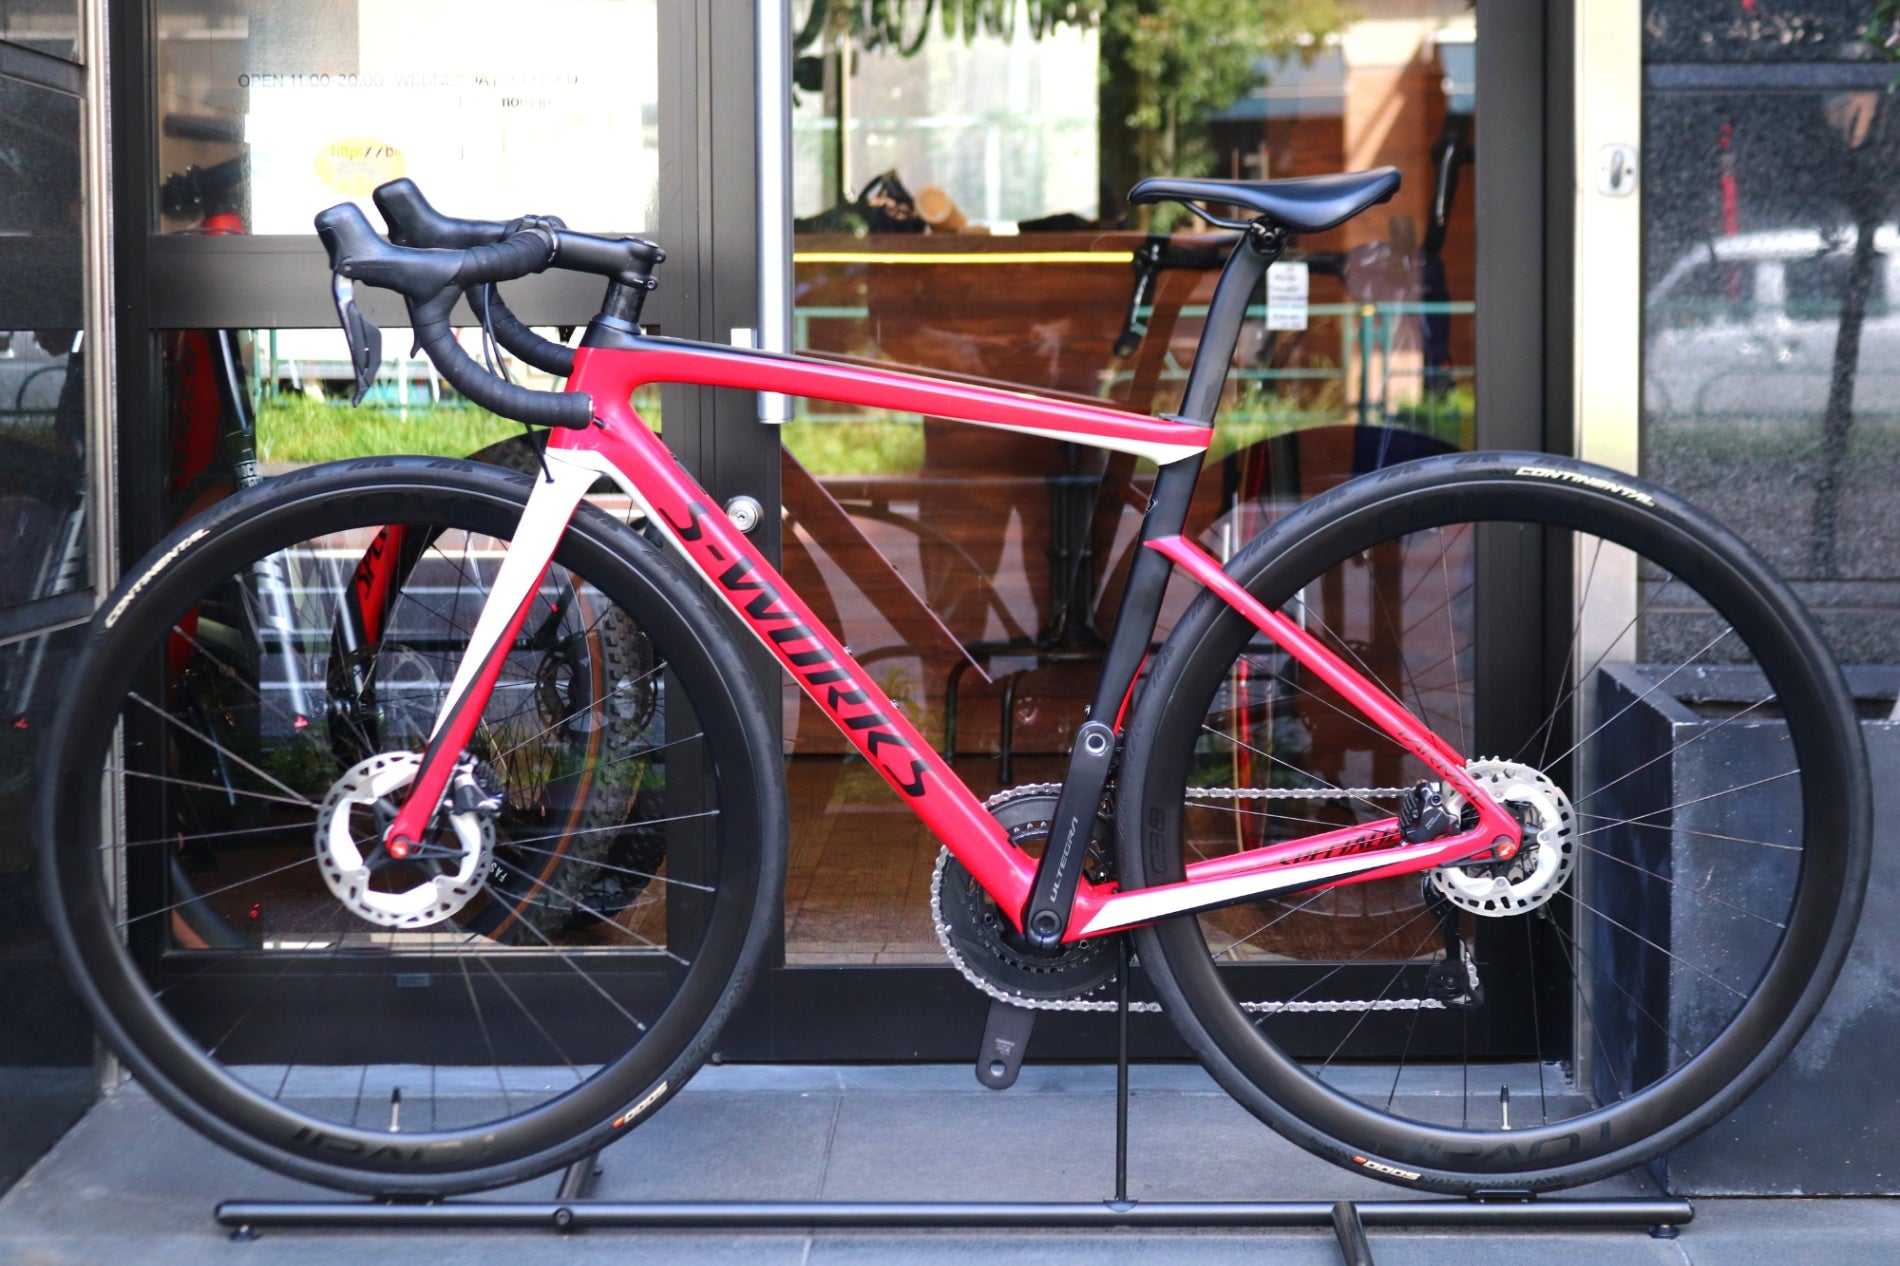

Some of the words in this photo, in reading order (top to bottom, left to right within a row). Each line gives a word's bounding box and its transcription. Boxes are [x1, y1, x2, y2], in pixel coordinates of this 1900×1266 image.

[237, 73, 284, 88] OPEN
[1514, 466, 1656, 508] CONTINENTAL
[104, 528, 211, 629] CONTINENTAL
[658, 500, 934, 798] S-WORKS
[488, 861, 509, 883] FAS
[1049, 815, 1080, 904] ULTEGRA
[1363, 1160, 1421, 1181] 5000
